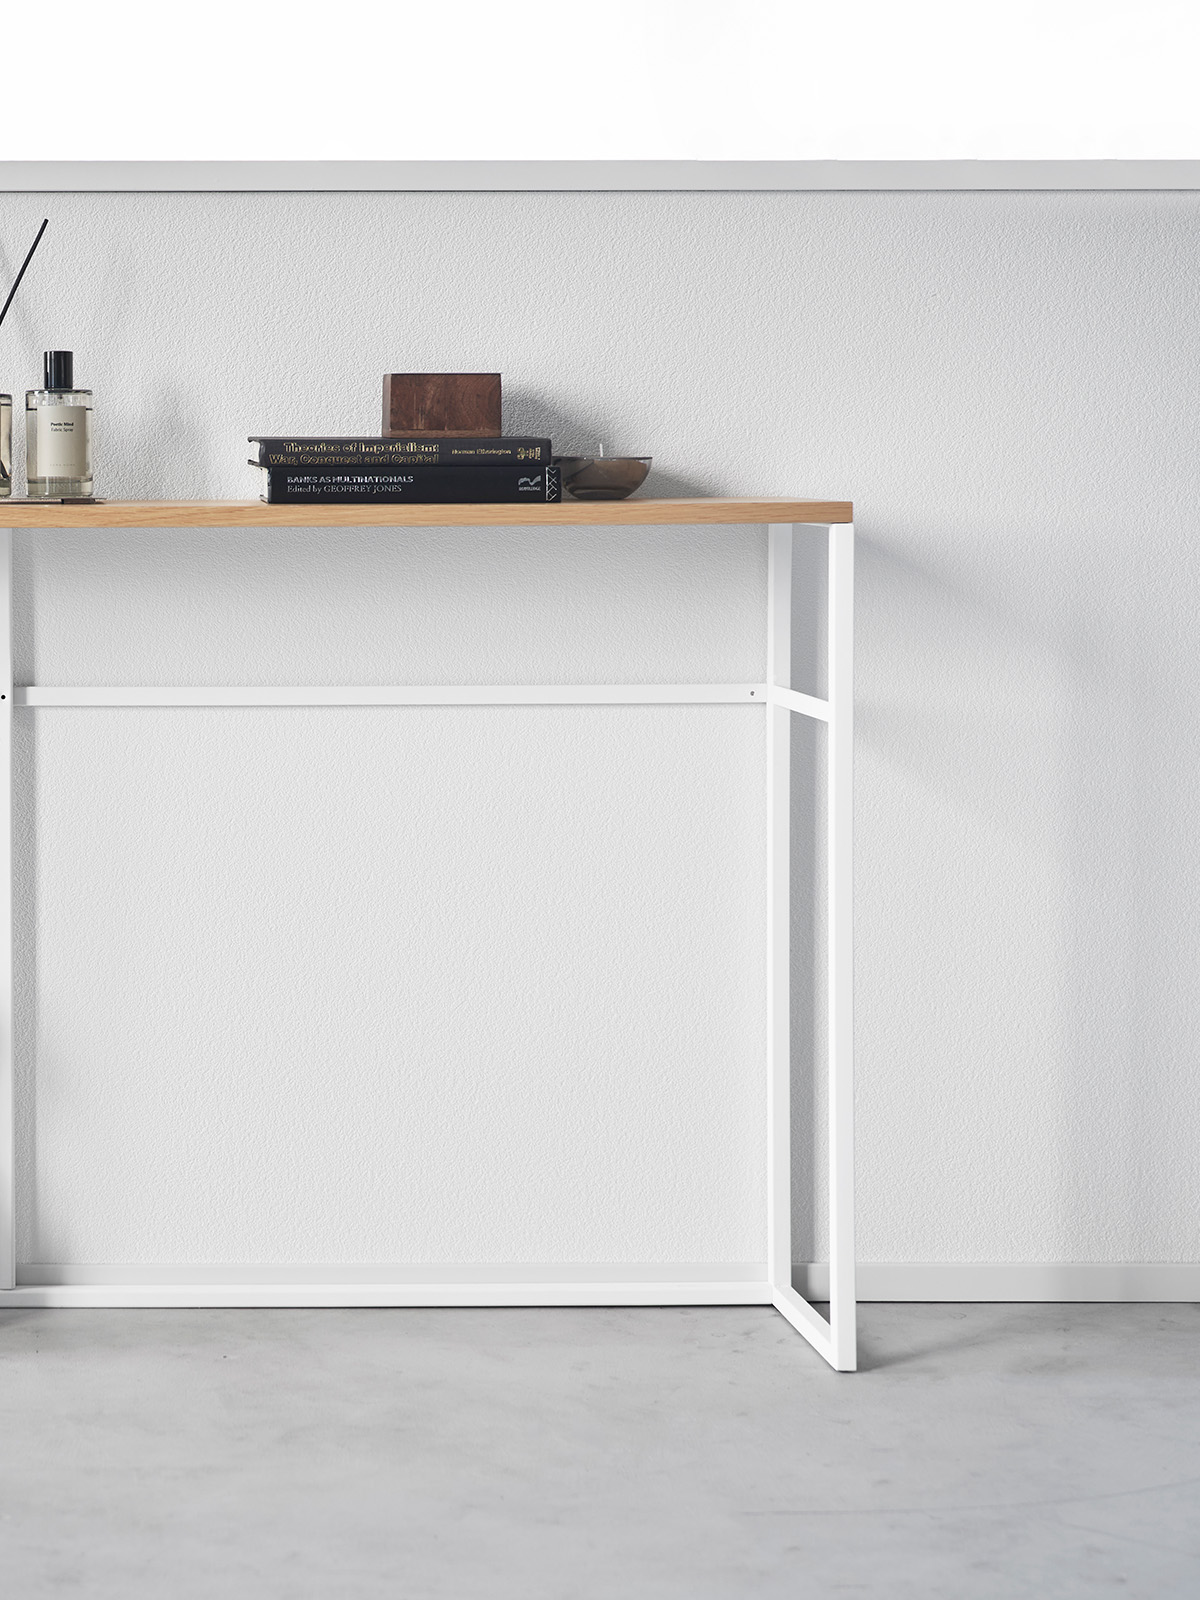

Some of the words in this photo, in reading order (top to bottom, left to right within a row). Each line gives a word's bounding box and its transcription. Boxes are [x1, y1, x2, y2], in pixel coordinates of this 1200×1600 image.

[283, 442, 341, 453] Theories
[342, 442, 357, 453] of
[268, 454, 299, 465] War,
[299, 453, 363, 466] Conquest
[364, 454, 390, 464] and
[391, 453, 440, 465] Capital
[332, 475, 414, 483] MULTINATIONALS
[287, 485, 311, 493] Edited
[312, 485, 323, 494] by
[323, 484, 372, 493] GEOFFREY
[372, 484, 402, 494] JONES
